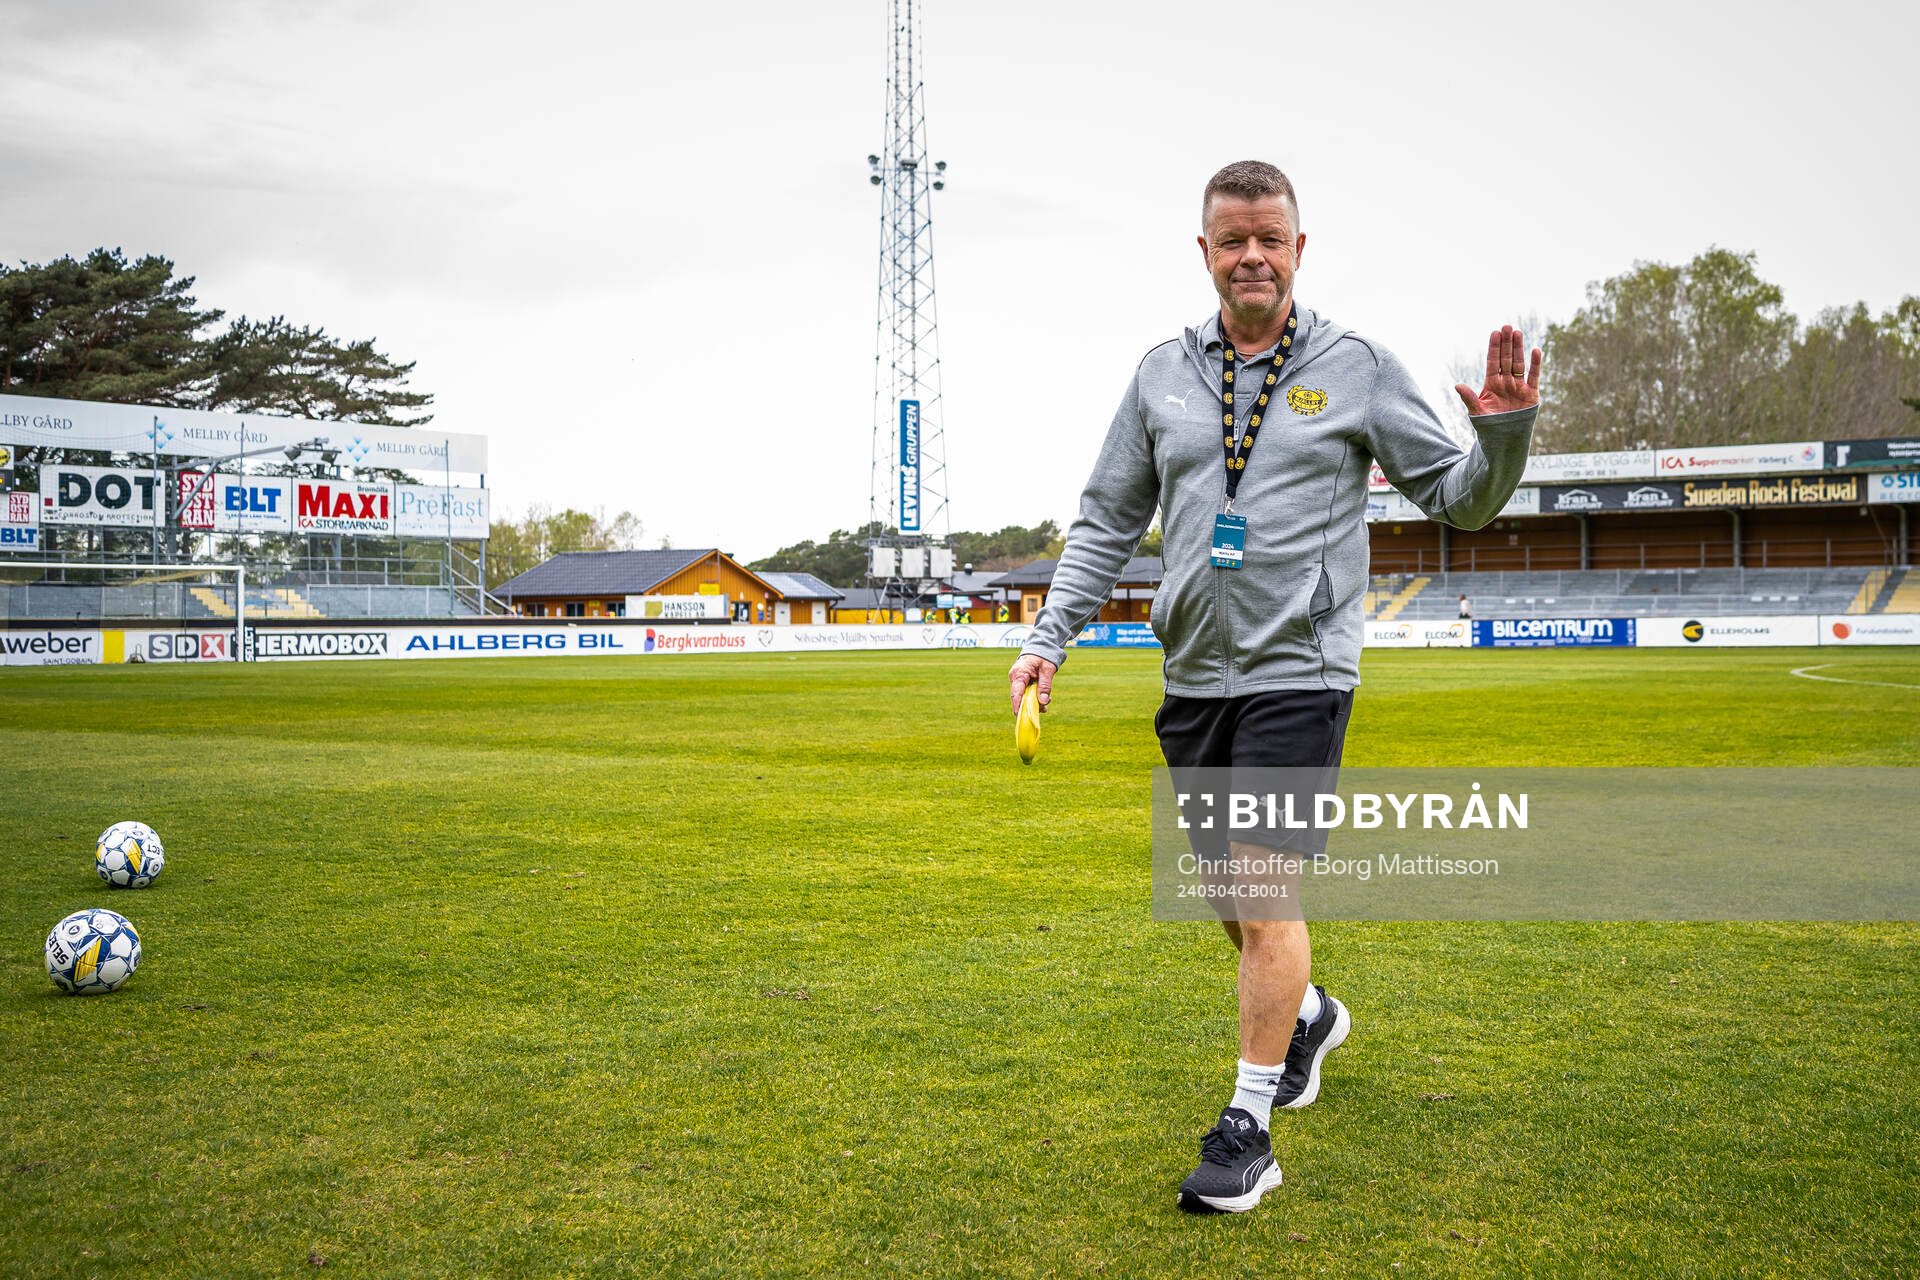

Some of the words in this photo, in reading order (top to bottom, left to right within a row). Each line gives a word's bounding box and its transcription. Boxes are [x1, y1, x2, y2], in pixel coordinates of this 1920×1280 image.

[0, 415, 30, 426] LBY
[33, 415, 73, 430] GÅRD
[183, 427, 231, 441] MELLBY
[234, 429, 268, 443] GÅRD
[906, 404, 917, 465] GRUPPEN
[377, 442, 417, 454] MELLBY
[419, 444, 447, 456] GÅRD
[1593, 454, 1629, 467] BYGG
[1633, 452, 1650, 465] AB
[1661, 456, 1684, 469] ICA
[1688, 456, 1754, 468] Supermarket
[182, 473, 213, 491] SYD
[357, 485, 388, 493] Bromölla
[10, 493, 29, 504] SYD
[58, 471, 161, 510] DOT
[1684, 480, 1746, 507] Sweden
[1749, 479, 1788, 505] Rock
[1790, 476, 1857, 503] Festival
[225, 486, 281, 512] BLT
[298, 484, 389, 520] MAXI
[400, 491, 484, 517] PreFast
[298, 517, 314, 528] ICA
[315, 519, 389, 531] STORMARKNAD
[1, 528, 37, 543] BLT
[664, 602, 704, 611] HANSSON
[1374, 631, 1406, 640] ELCOM
[1425, 631, 1458, 640] ELCOM
[1710, 627, 1770, 635] ELLEHOLMS
[6, 632, 92, 653] weber
[149, 634, 225, 658] SDX
[244, 626, 255, 661] SELECT
[406, 634, 567, 651] AHLBERG
[578, 633, 624, 649] BIL
[658, 632, 746, 652] Bergkvarabuss
